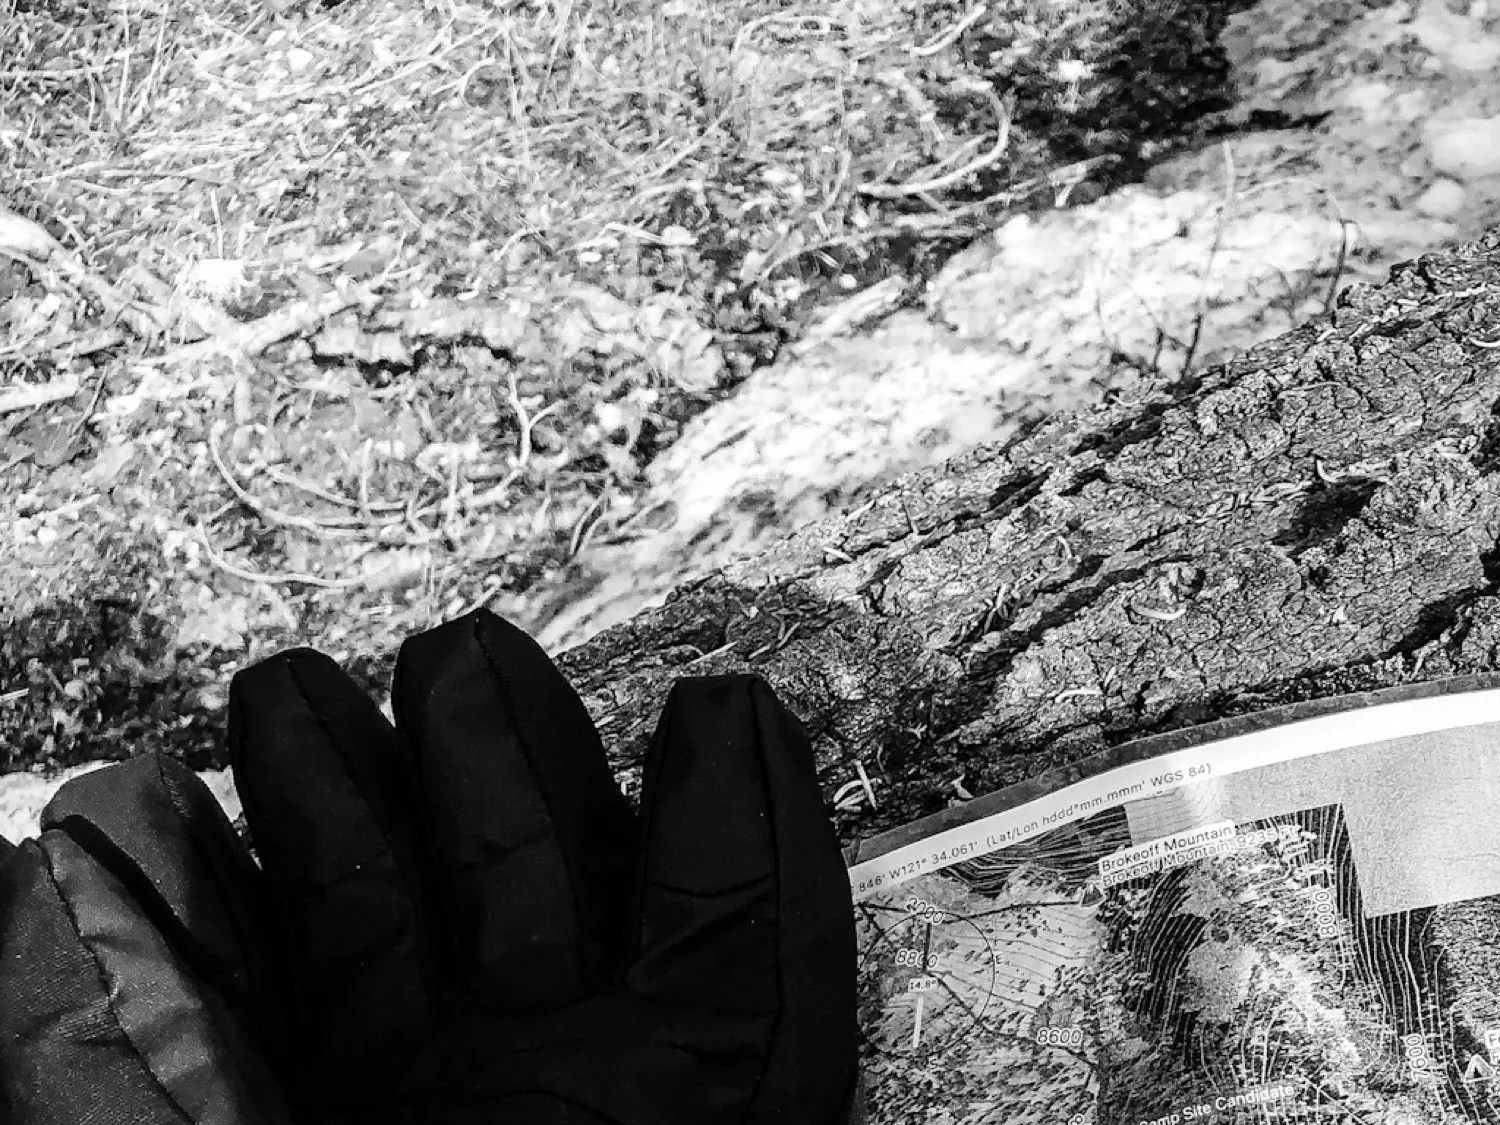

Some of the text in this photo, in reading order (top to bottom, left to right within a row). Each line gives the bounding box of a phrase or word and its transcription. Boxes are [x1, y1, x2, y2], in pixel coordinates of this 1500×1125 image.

[853, 875, 885, 894] .846'
[1150, 770, 1184, 788] WGS
[1188, 762, 1212, 779] 84)
[1102, 823, 1233, 872] Brokeoff Mountain
[1102, 860, 1161, 887] Brokeoff
[1316, 890, 1336, 937] 8000
[1037, 1029, 1083, 1045] 8600
[1183, 1101, 1212, 1122] Site
[1215, 1083, 1295, 1111] Candidate
